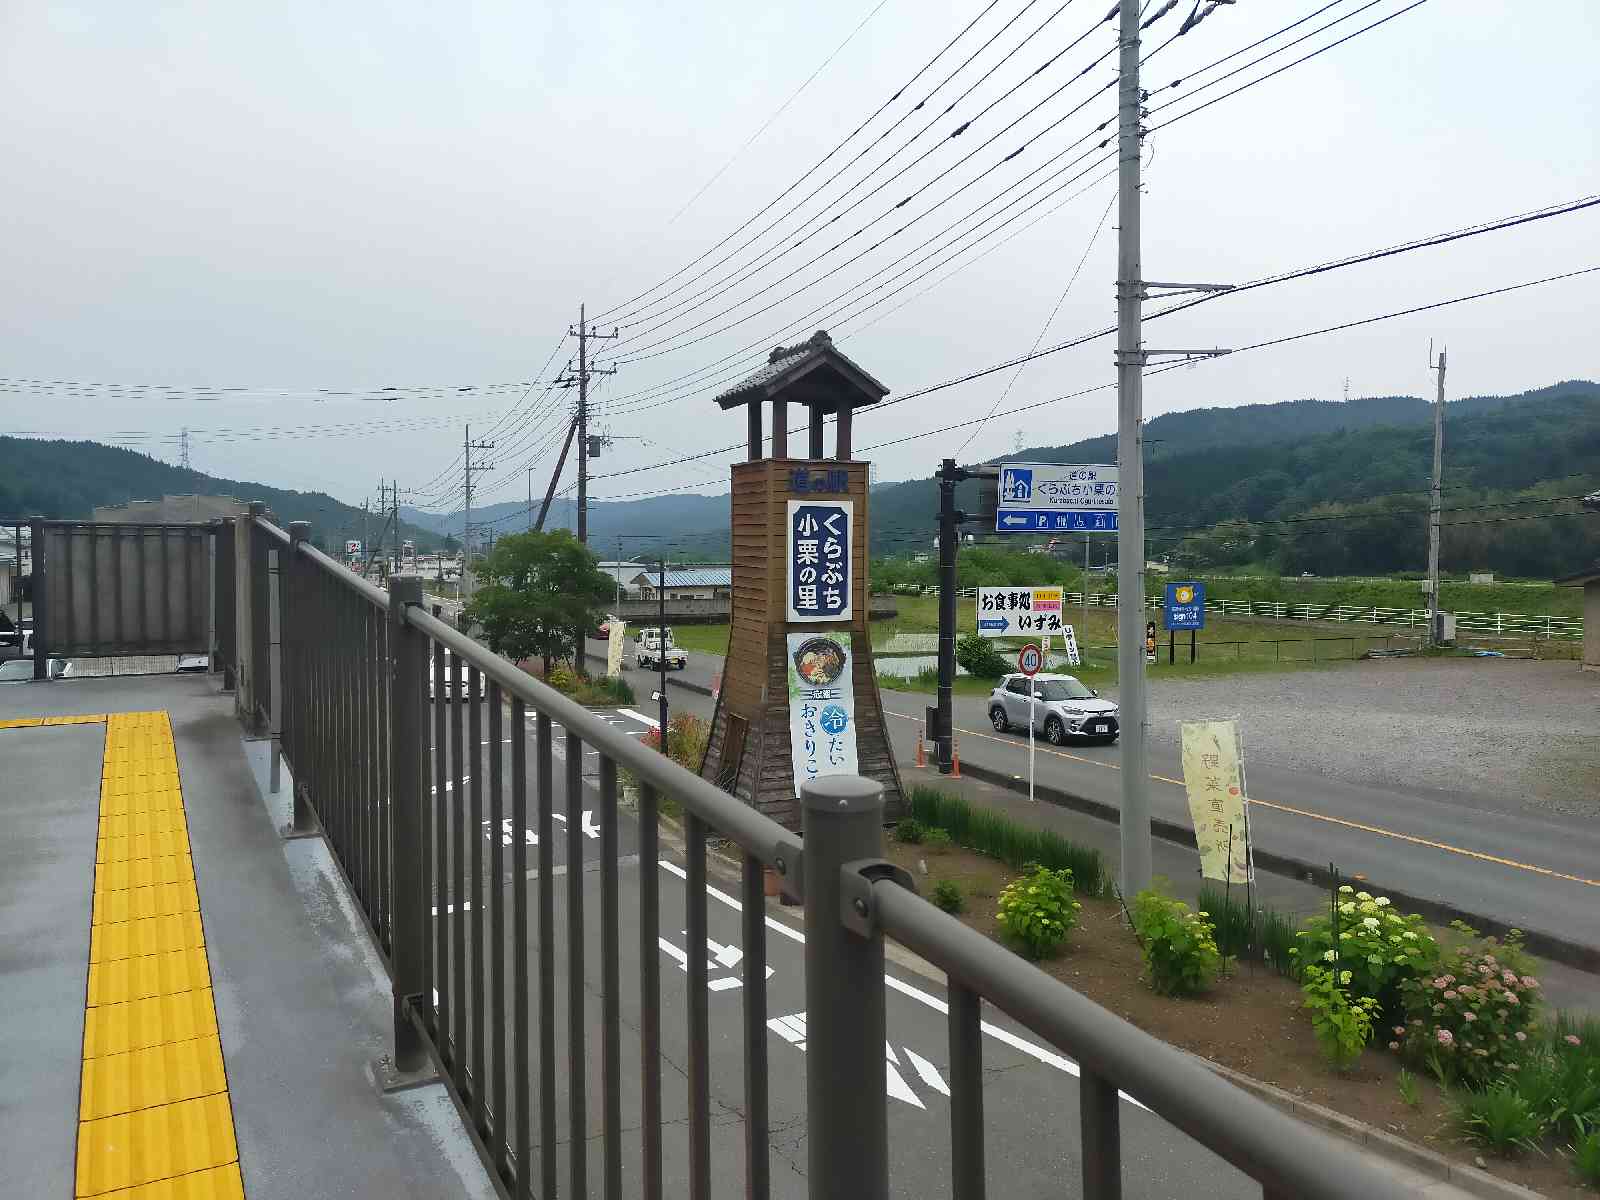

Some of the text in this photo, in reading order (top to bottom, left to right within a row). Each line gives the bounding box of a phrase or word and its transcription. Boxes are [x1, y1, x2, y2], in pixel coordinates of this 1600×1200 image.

[797, 513, 819, 610] 小栗の里
[821, 513, 843, 609] くらぶち
[982, 592, 1031, 610] お食事処
[1019, 613, 1061, 631] いずみ
[1024, 653, 1037, 667] 40
[801, 704, 818, 783] おきりこ
